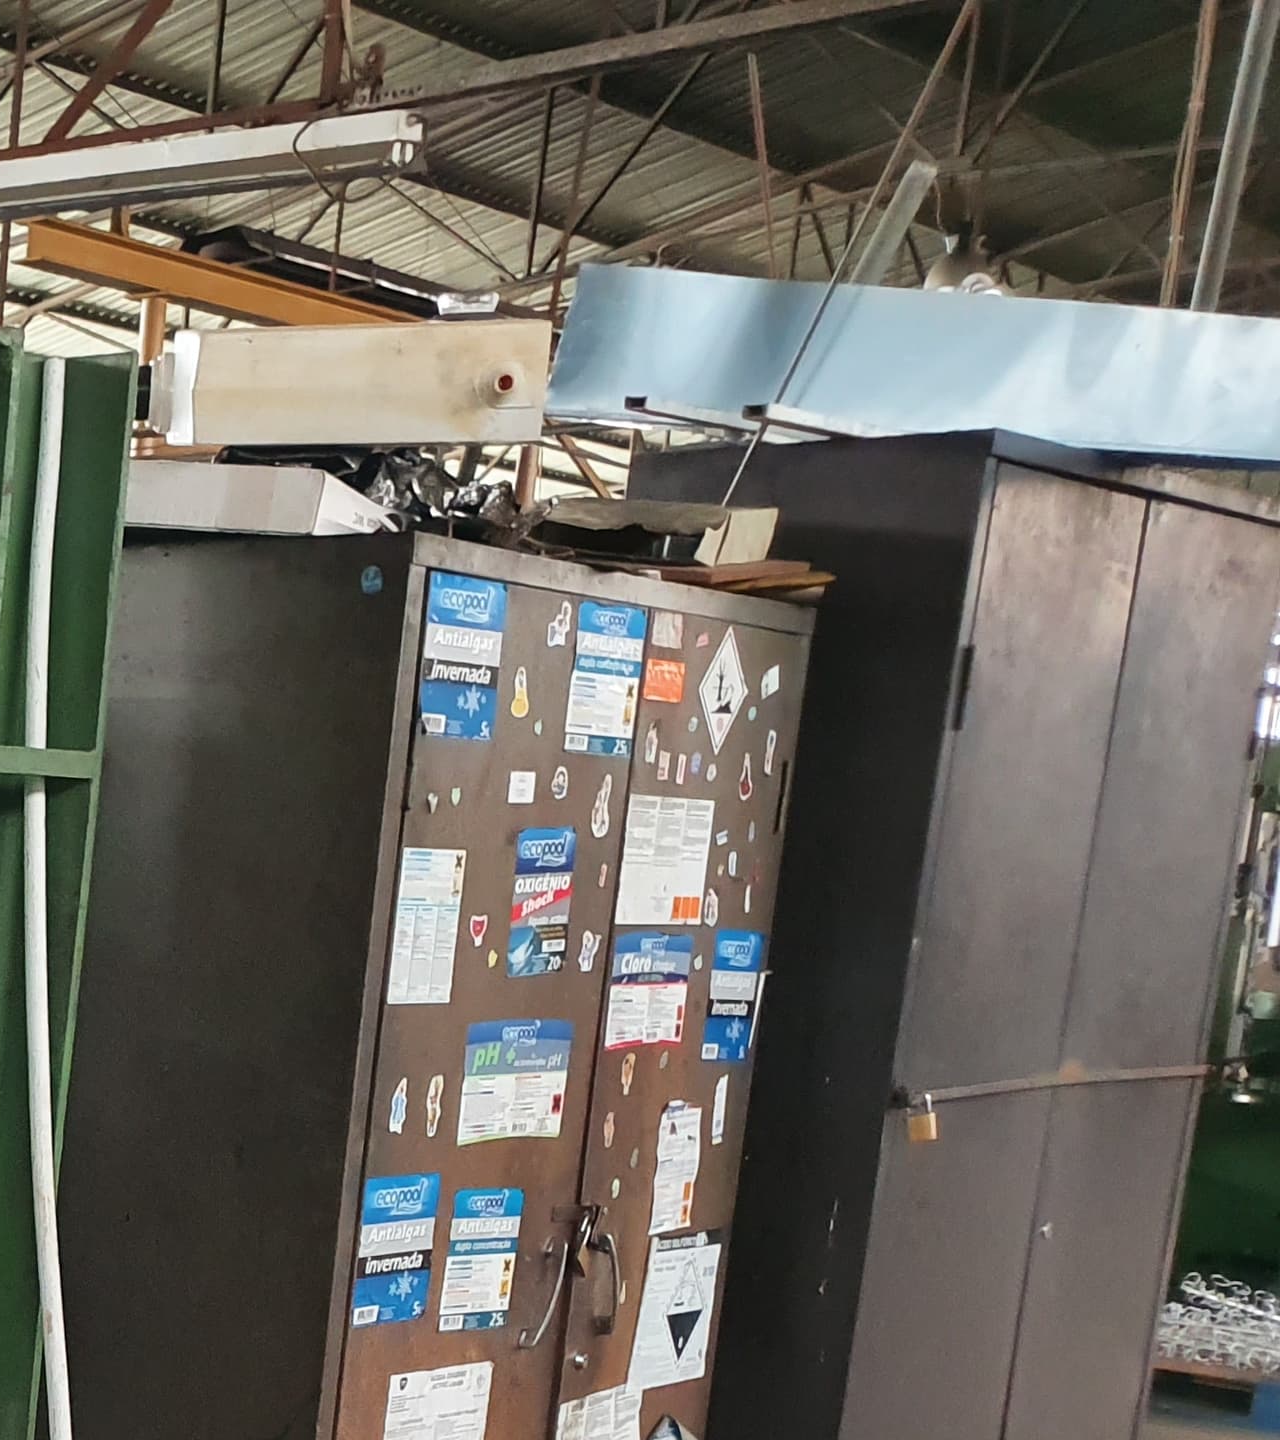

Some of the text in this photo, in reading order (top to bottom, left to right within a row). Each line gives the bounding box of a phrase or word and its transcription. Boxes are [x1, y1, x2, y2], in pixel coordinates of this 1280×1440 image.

[442, 586, 491, 616] ecopool
[433, 628, 494, 654] Antialgas
[430, 660, 491, 684] invernada
[522, 833, 568, 862] ecopool
[621, 953, 652, 974] Cloro
[472, 1042, 501, 1074] pH
[376, 1181, 425, 1208] ecopool
[470, 1191, 506, 1212] ecopool
[368, 1224, 426, 1244] Antialgas
[458, 1220, 513, 1237] Antialgas
[365, 1251, 423, 1275] invernada
